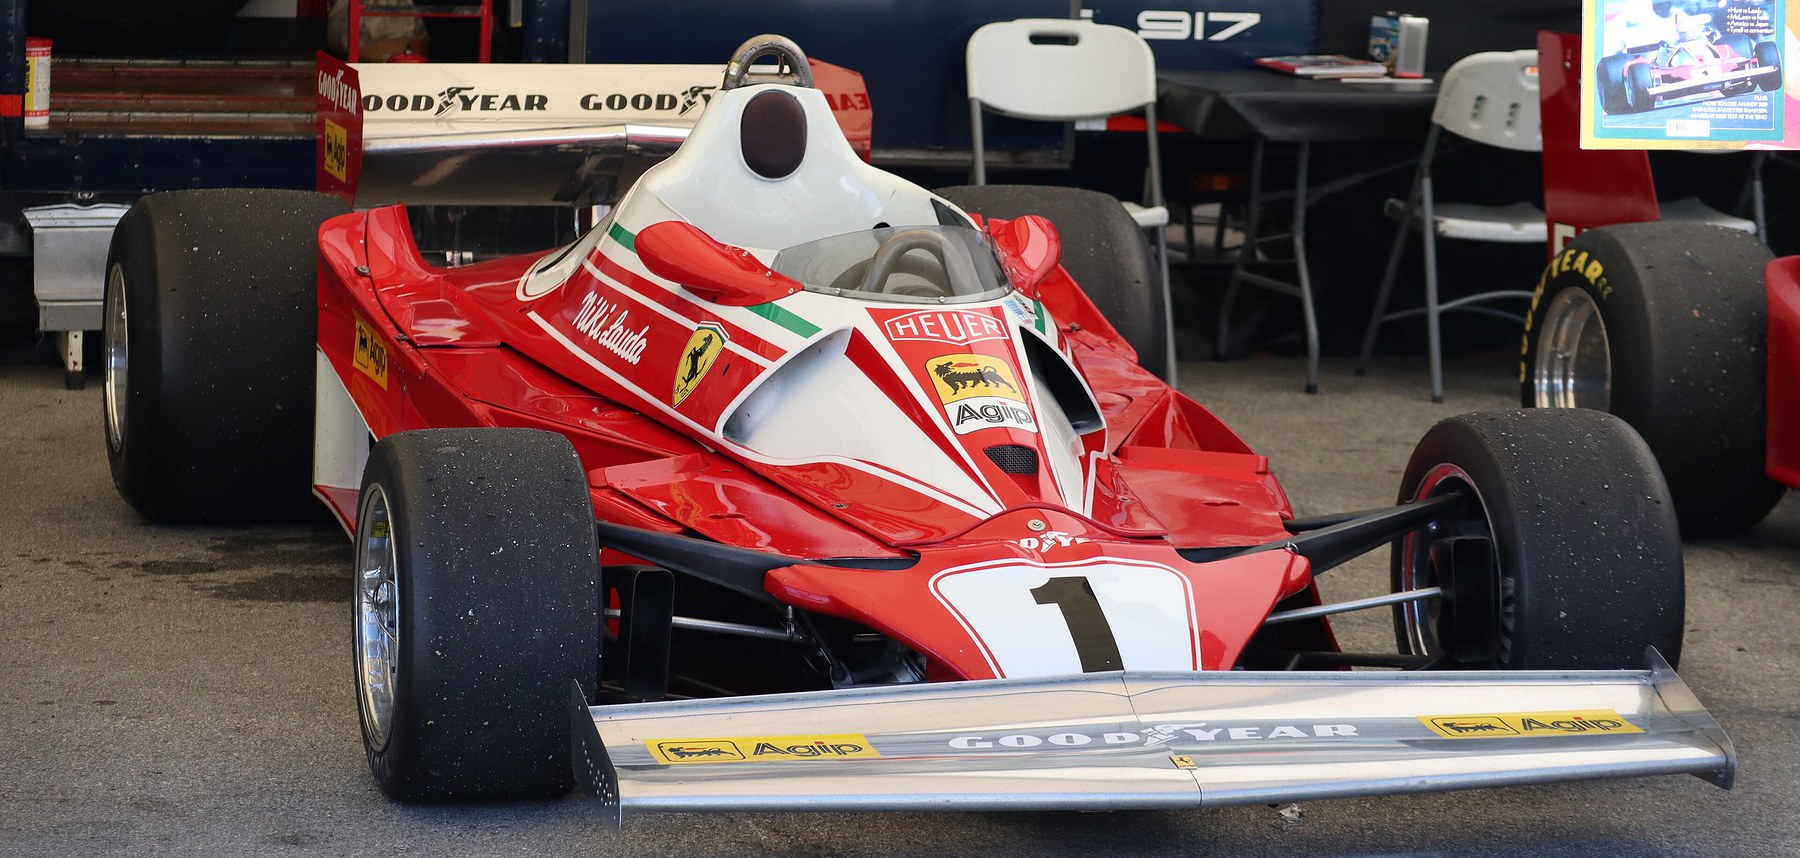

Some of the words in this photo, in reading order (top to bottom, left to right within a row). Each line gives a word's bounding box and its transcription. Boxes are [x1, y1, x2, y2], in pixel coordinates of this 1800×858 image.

[1137, 10, 1261, 41] 917
[895, 313, 1002, 341] HEUER
[955, 402, 1033, 427] Agip
[1029, 575, 1125, 674] 1
[1520, 716, 1623, 732] Agip
[752, 740, 864, 757] Agip
